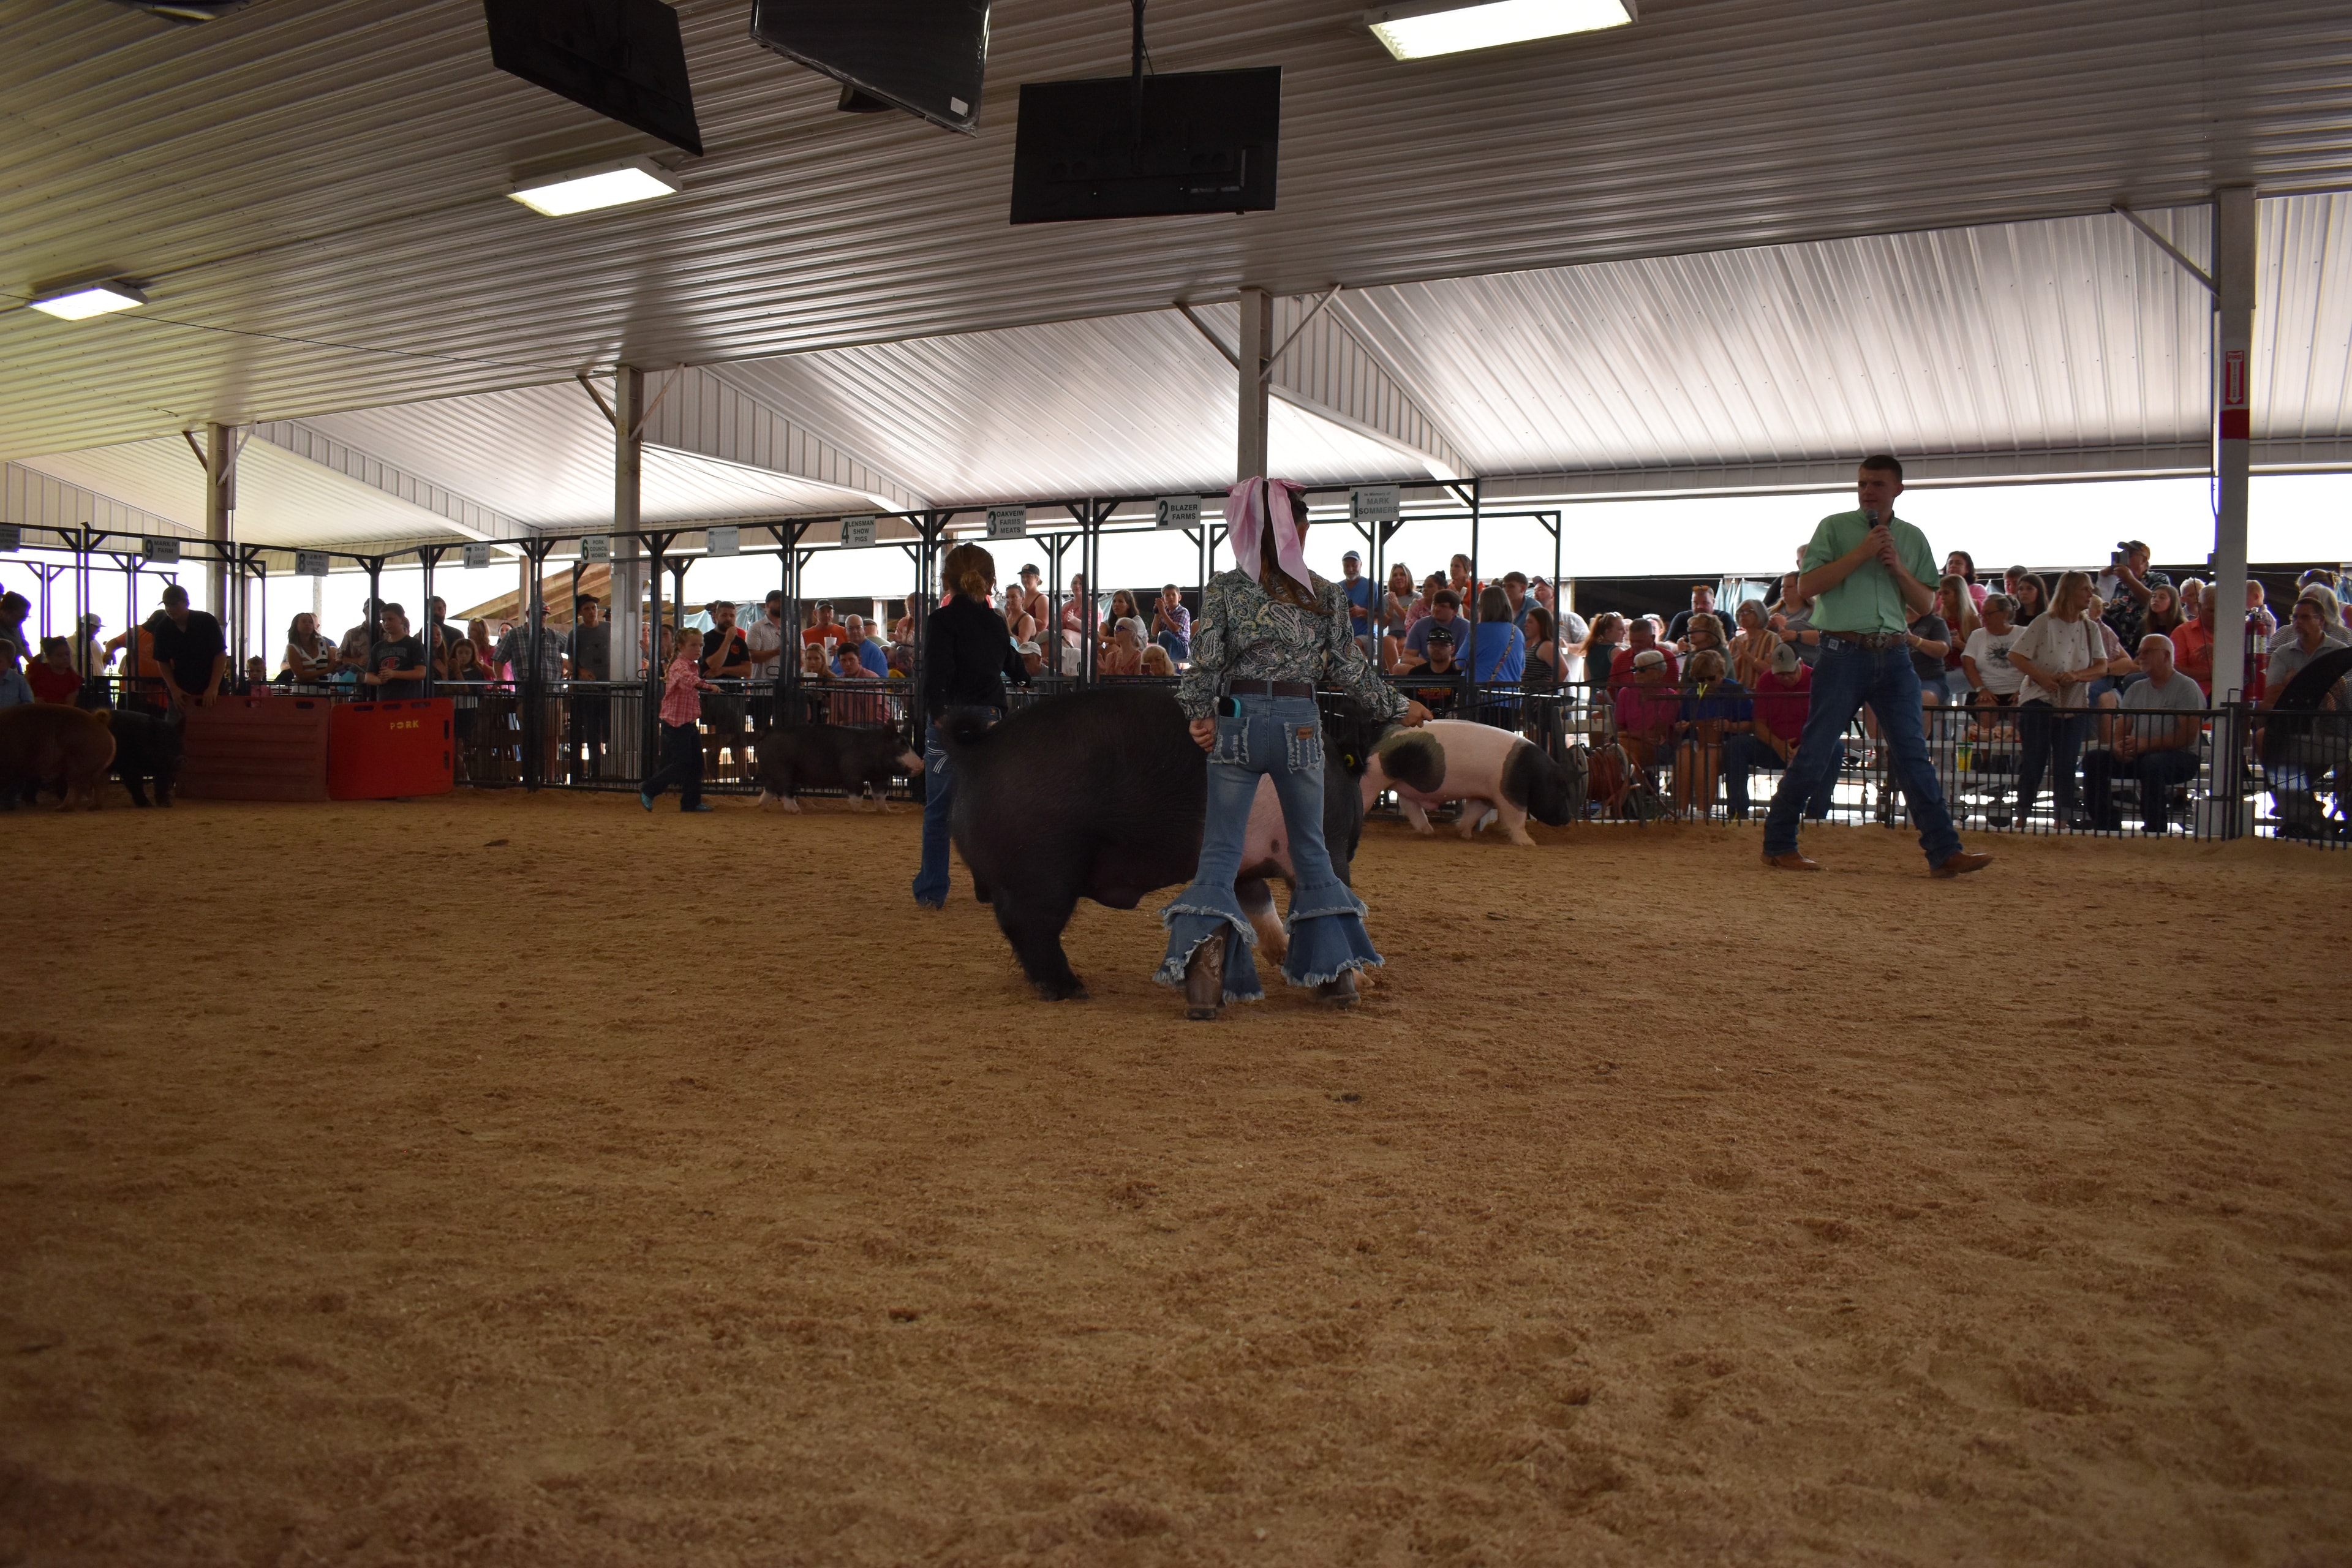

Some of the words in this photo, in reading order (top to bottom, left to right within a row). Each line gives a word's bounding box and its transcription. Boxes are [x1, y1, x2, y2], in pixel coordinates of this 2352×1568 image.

[1159, 500, 1168, 526] 2
[1351, 492, 1358, 518] 1
[842, 521, 849, 543] 4
[988, 511, 996, 535] 3
[146, 540, 153, 559] 9
[582, 539, 589, 560] 6
[708, 531, 715, 552] 5
[298, 553, 305, 572] 8
[466, 547, 472, 566] 7
[390, 720, 419, 729] PORK
